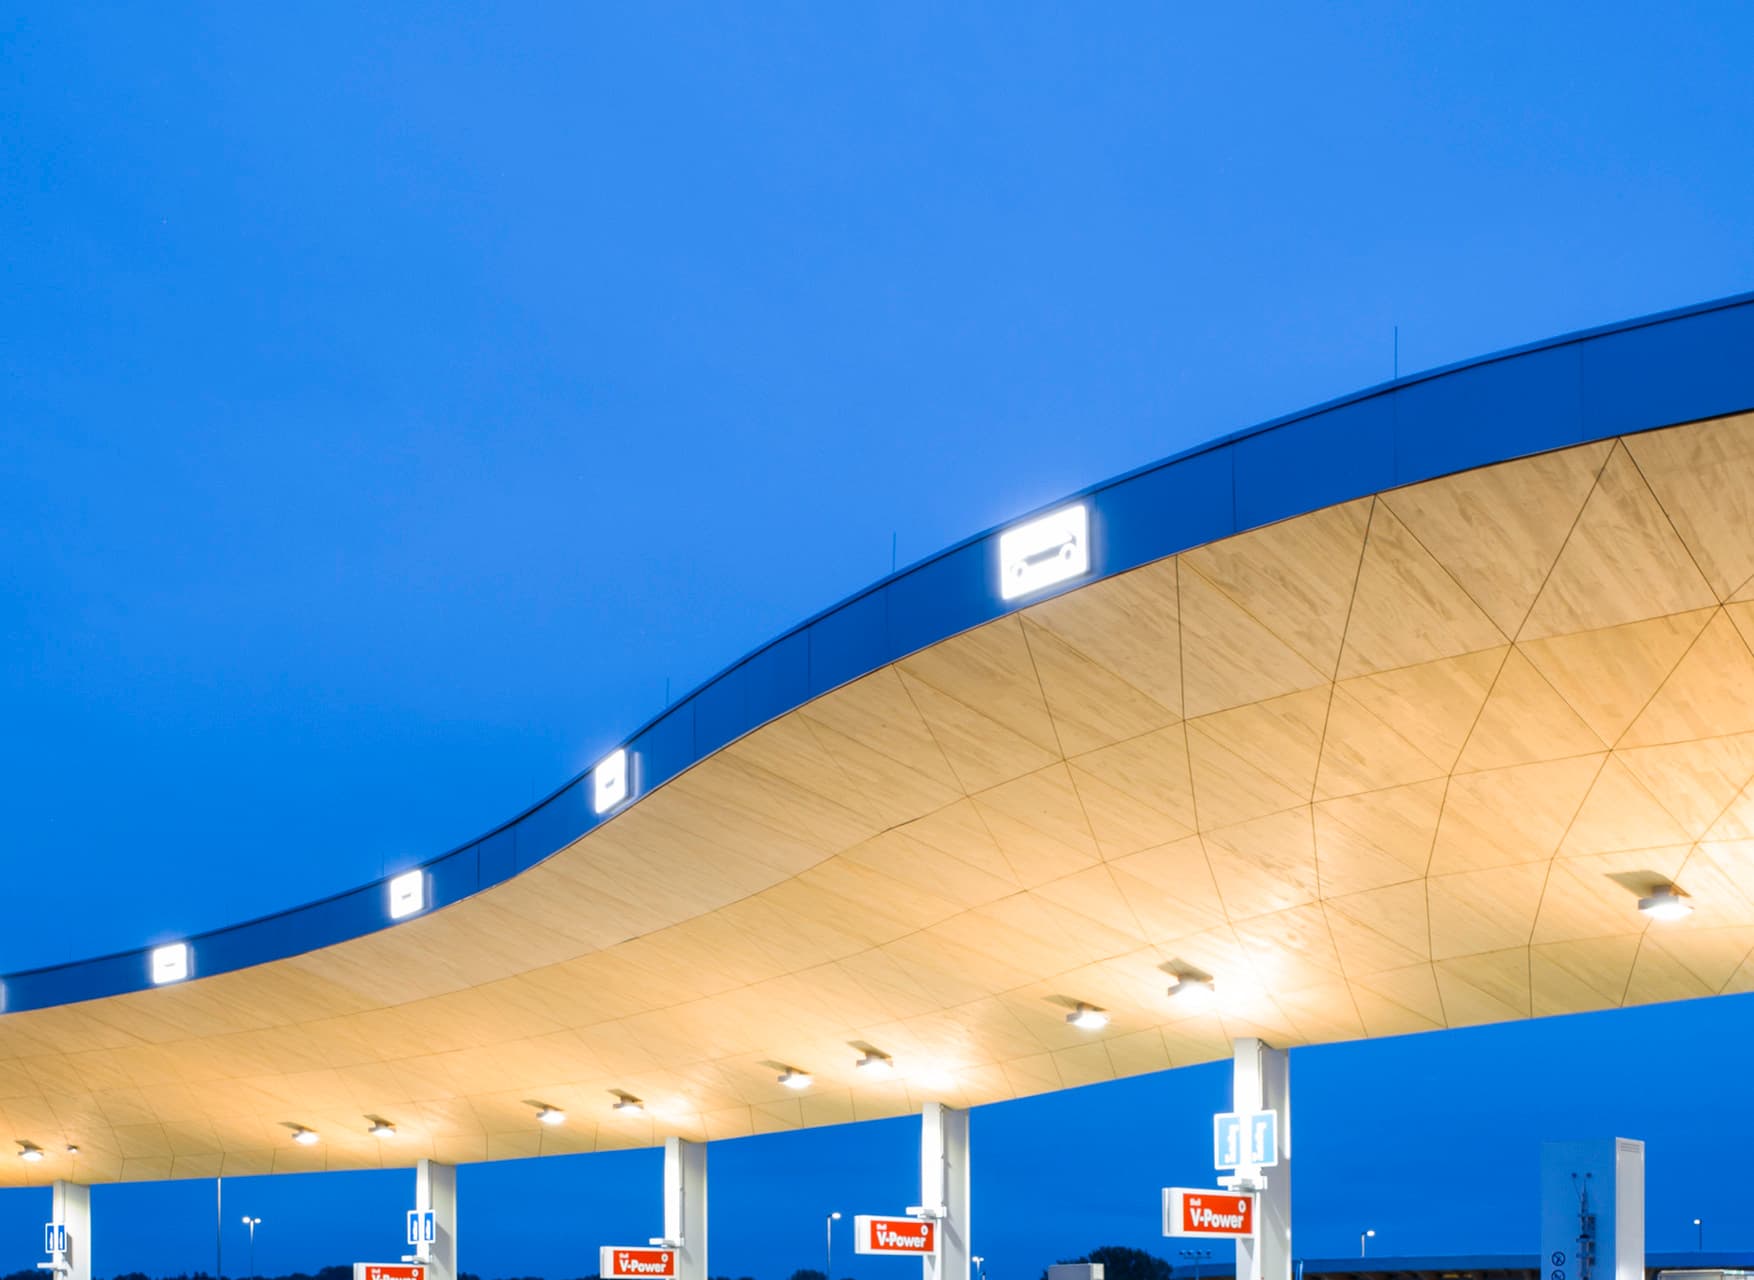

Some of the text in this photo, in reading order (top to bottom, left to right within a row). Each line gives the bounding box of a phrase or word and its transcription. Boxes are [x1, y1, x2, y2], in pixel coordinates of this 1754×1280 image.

[1189, 1208, 1244, 1229] V-Power
[876, 1231, 926, 1248] V-Power
[619, 1259, 667, 1273] V-Power
